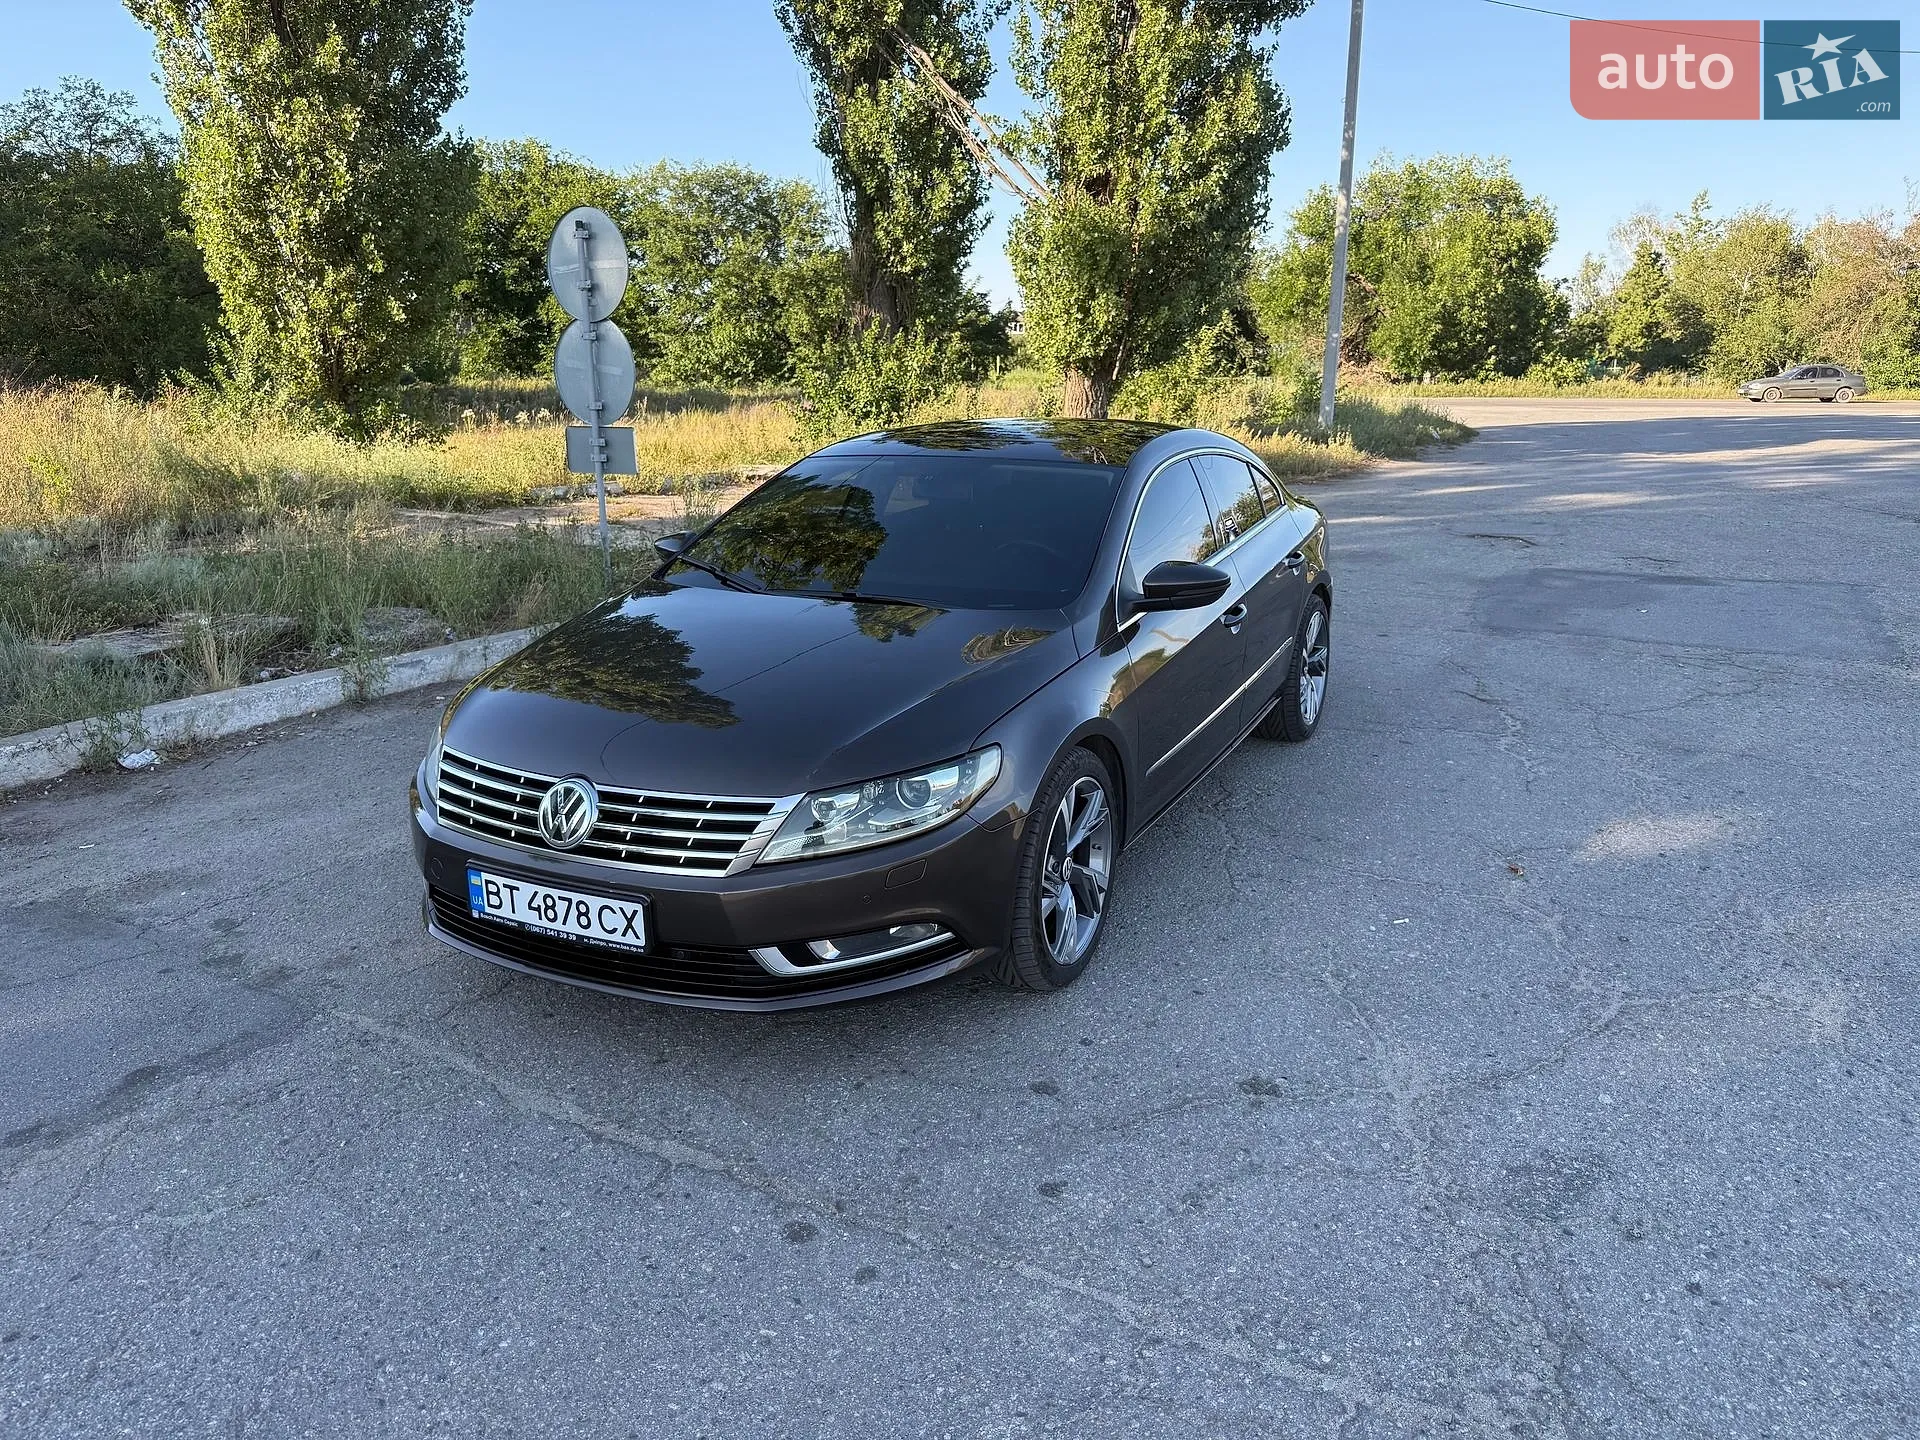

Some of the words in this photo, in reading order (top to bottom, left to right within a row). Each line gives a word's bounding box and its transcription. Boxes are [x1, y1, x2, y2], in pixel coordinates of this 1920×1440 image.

[472, 895, 483, 905] UA
[484, 879, 520, 914] BT
[527, 890, 592, 930] 4878
[597, 904, 641, 940] CX
[530, 925, 546, 934] (067)
[546, 929, 558, 937] 541
[559, 931, 567, 939] 39
